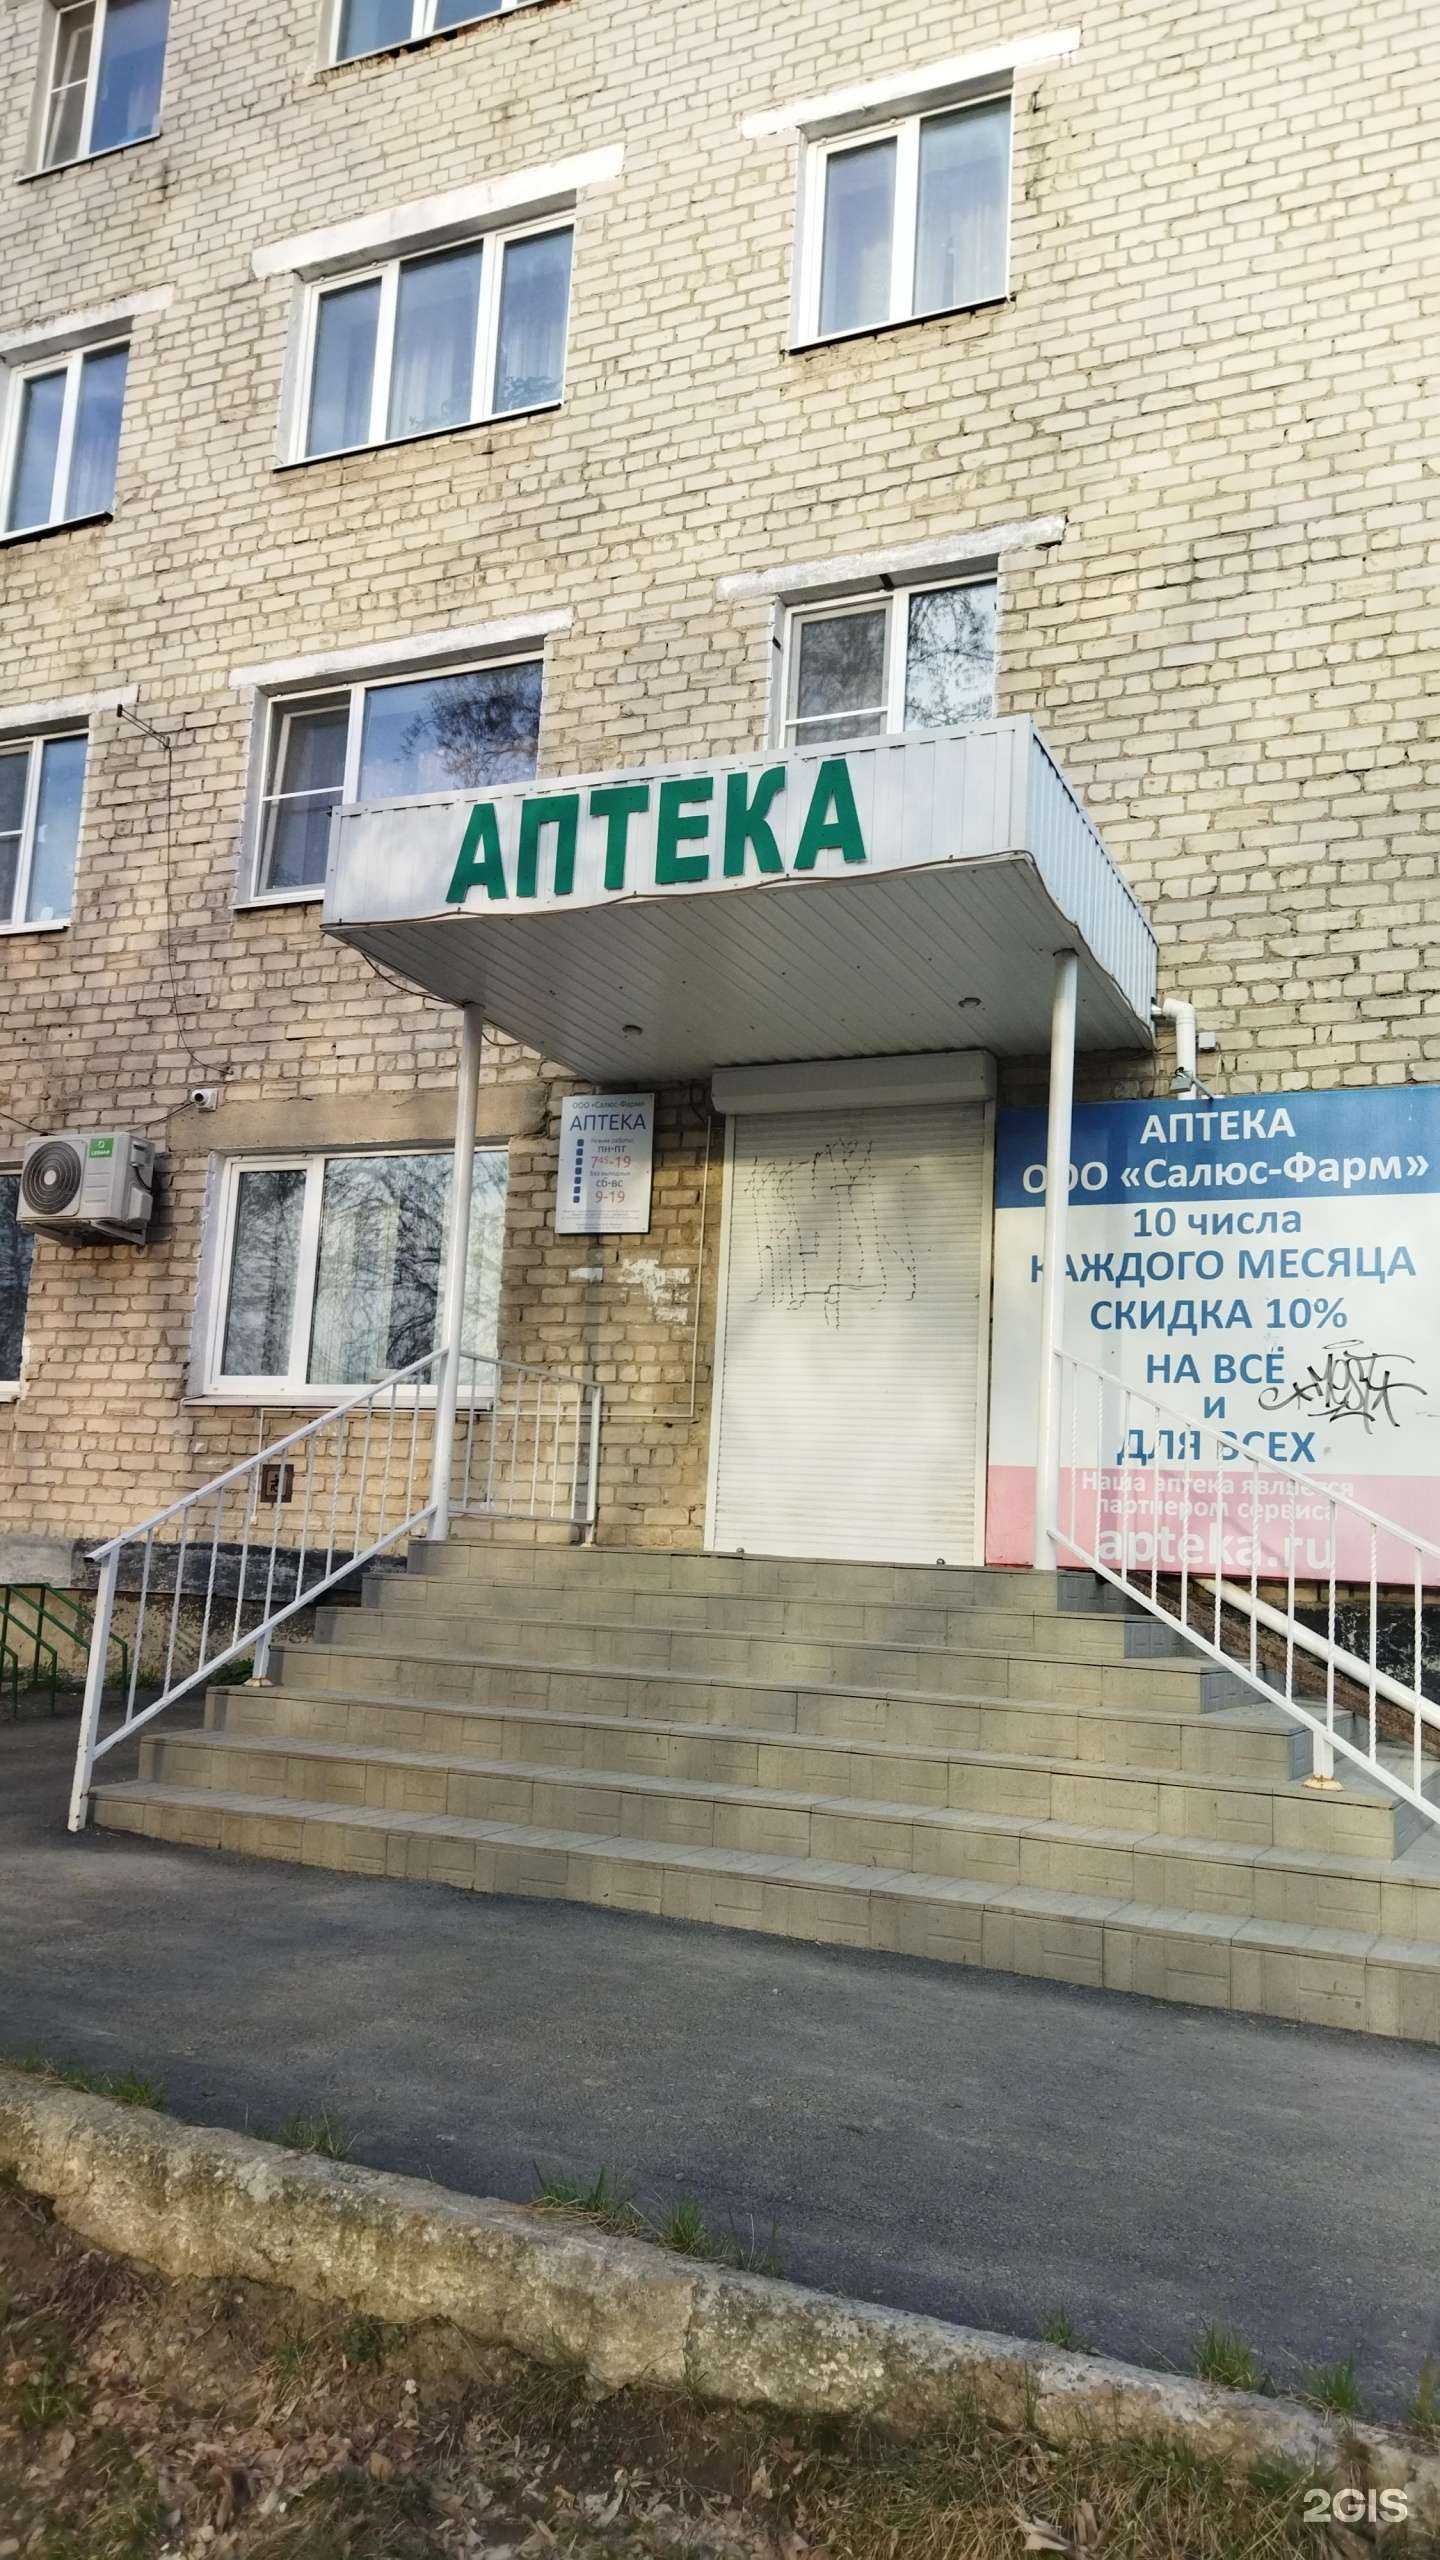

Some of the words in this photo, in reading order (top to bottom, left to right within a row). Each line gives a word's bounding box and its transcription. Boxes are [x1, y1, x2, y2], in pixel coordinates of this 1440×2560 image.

[445, 758, 867, 904] АПТЕКА
[569, 1113, 647, 1132] АПТЕКА
[1139, 1107, 1296, 1145] АПТЕКА
[1120, 1150, 1430, 1190] «Салюс-Фарм»
[1133, 1207, 1177, 1238] 10
[1188, 1208, 1302, 1236] числа
[1238, 1246, 1417, 1285] МЕСЯЦА
[1090, 1298, 1253, 1337] СКИДКА
[1266, 1296, 1348, 1330] 10%
[1146, 1354, 1200, 1385] НА
[1214, 1346, 1285, 1385] ВСЁ
[1116, 1429, 1201, 1466] ДЛЯ
[1098, 1522, 1332, 1571] apteka.ru
